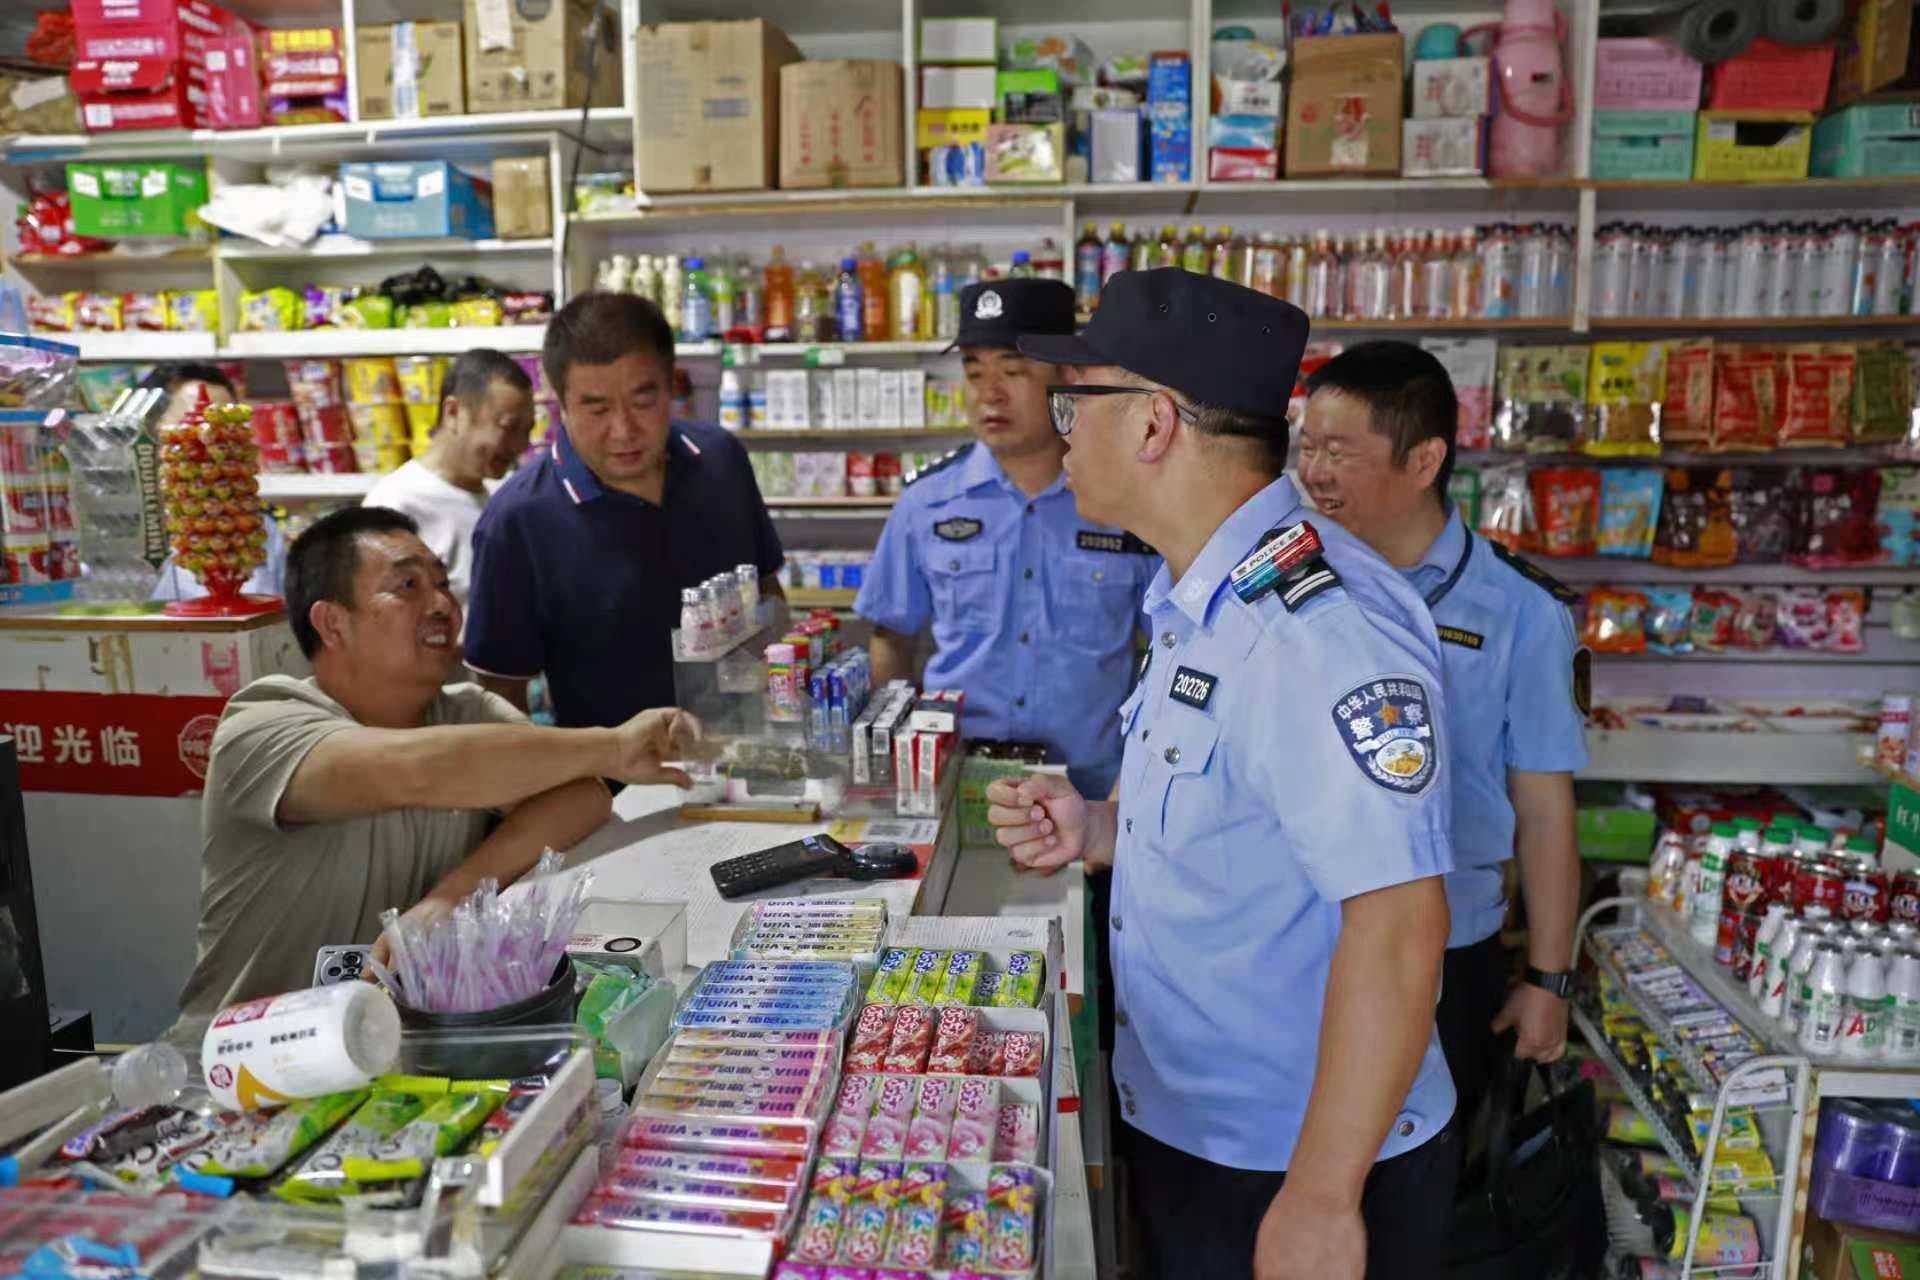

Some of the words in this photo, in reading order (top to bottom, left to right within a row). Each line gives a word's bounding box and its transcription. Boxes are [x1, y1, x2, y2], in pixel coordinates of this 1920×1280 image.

[1249, 538, 1286, 567] POLICE
[1174, 673, 1210, 701] 202726
[1336, 682, 1424, 720] 中华人民共和国
